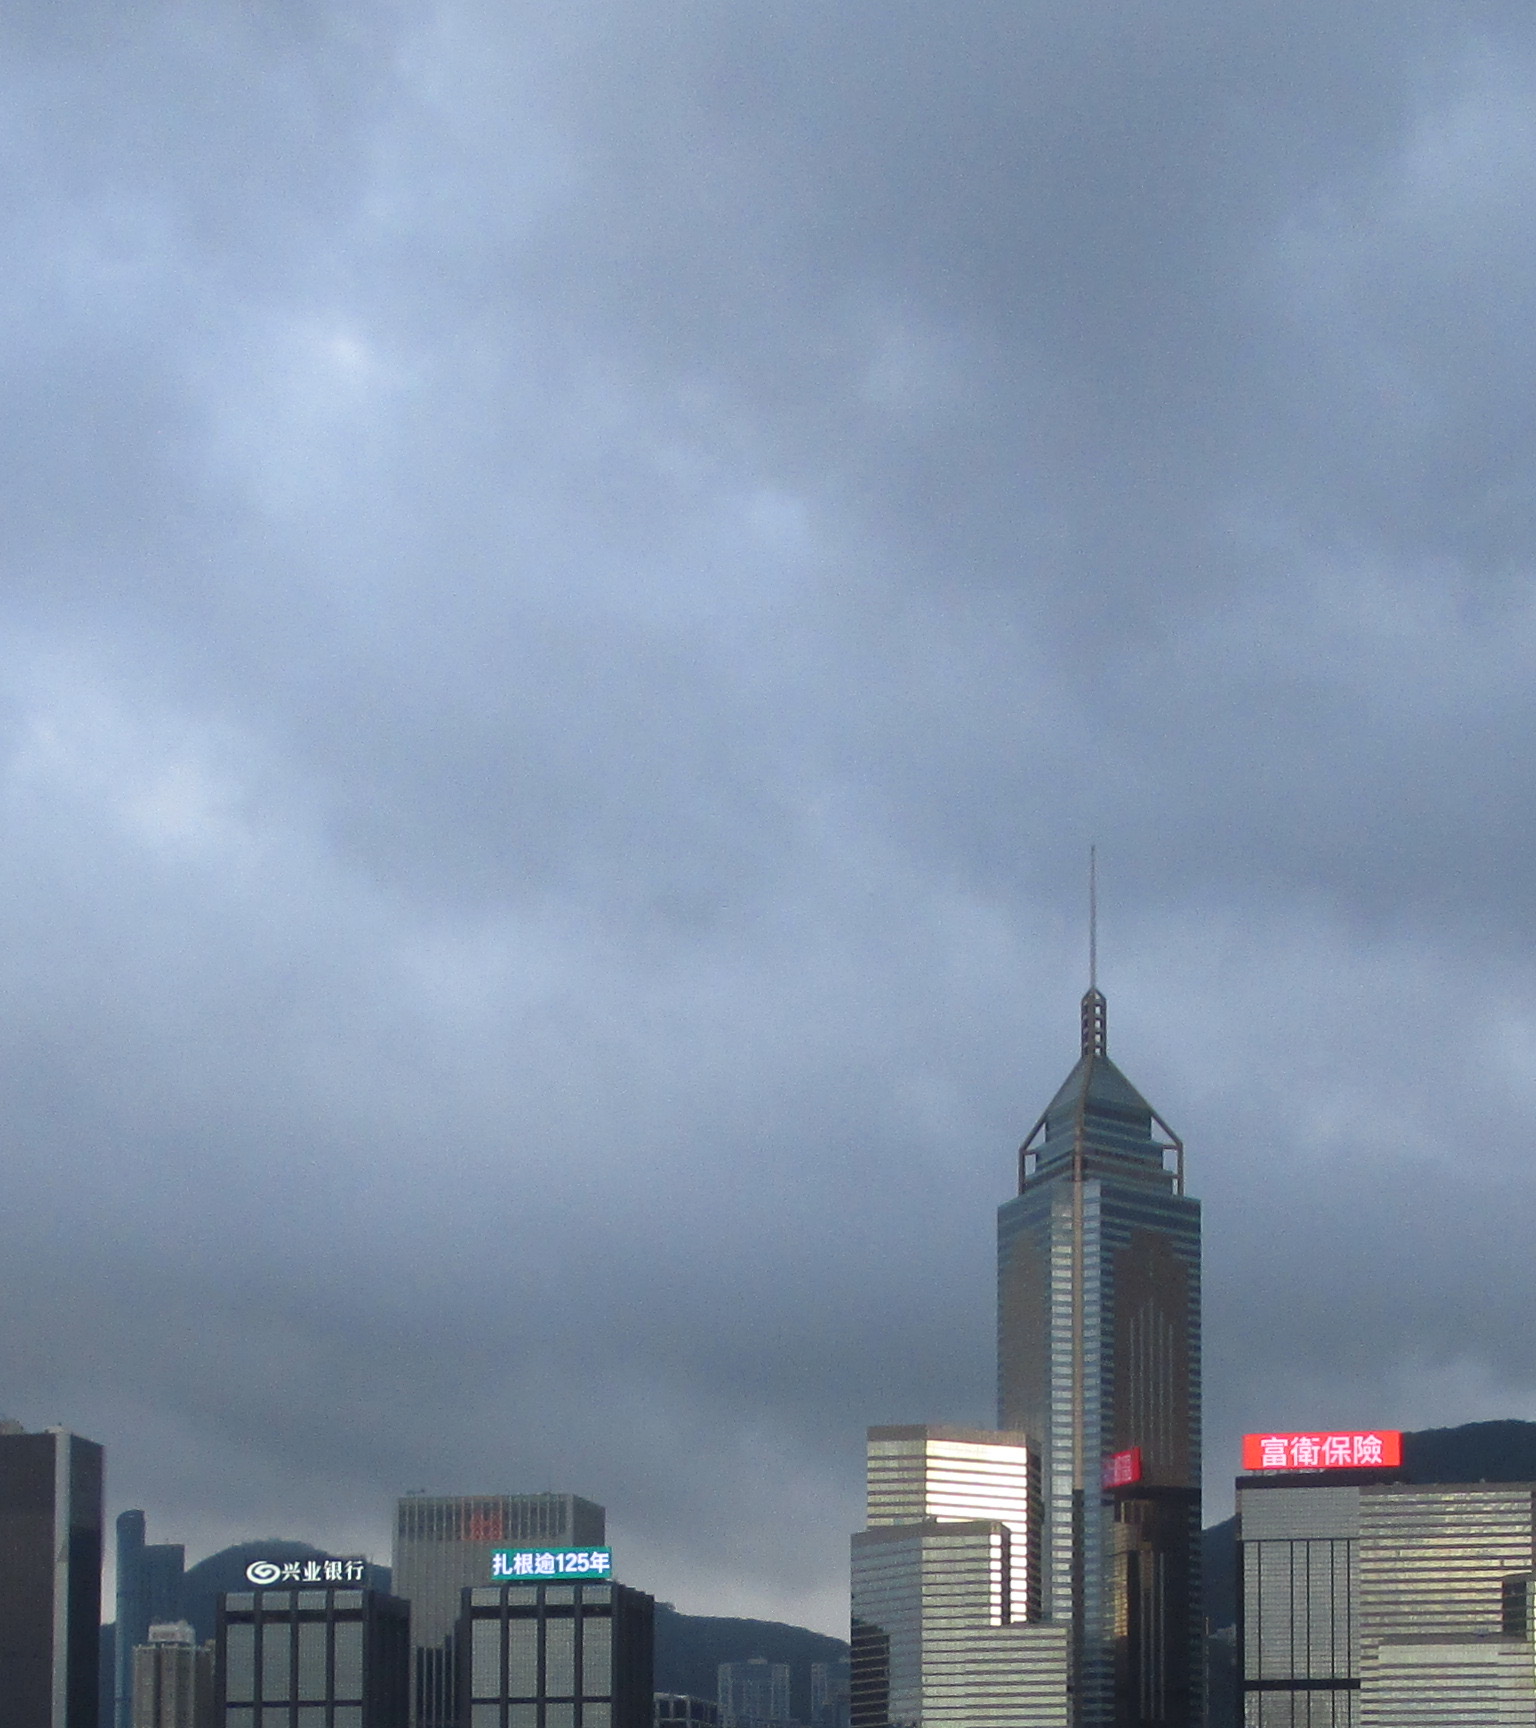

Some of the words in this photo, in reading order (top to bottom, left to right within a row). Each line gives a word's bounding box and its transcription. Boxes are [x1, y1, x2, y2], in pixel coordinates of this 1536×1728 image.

[1260, 1434, 1383, 1467] 富衛保險
[282, 1560, 364, 1582] 兴业银行
[492, 1551, 611, 1576] 扎根逾125年
